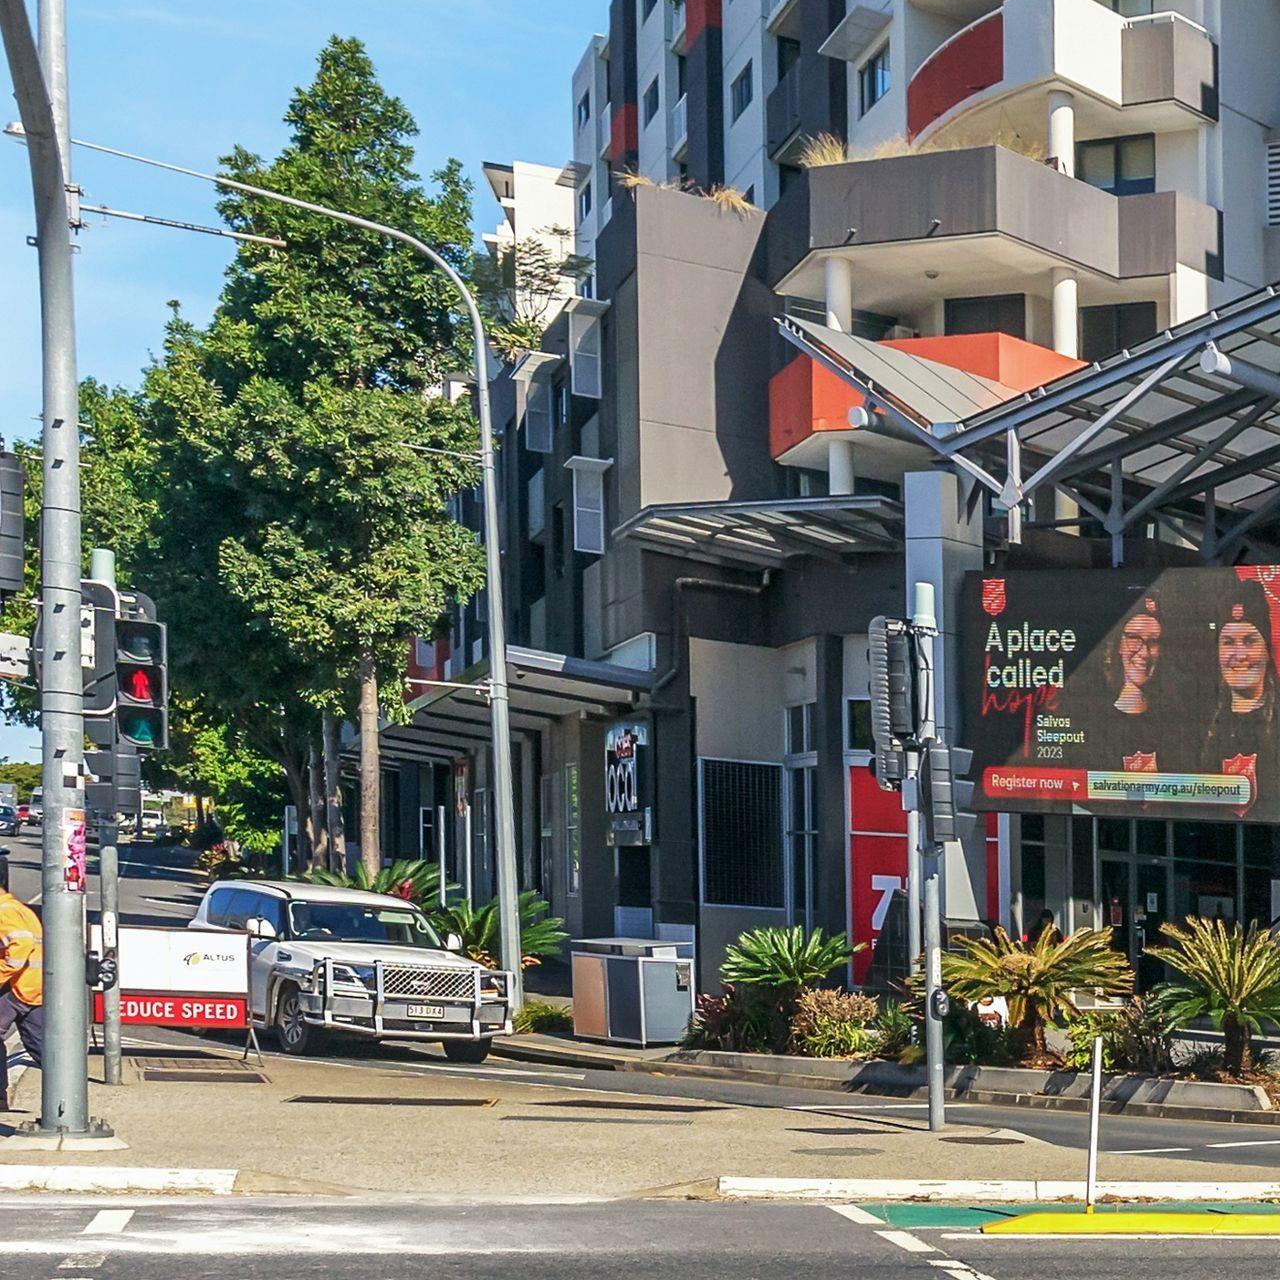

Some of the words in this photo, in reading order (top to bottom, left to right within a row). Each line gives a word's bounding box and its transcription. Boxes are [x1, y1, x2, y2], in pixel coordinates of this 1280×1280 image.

[984, 621, 1005, 652] A
[1006, 622, 1077, 660] place
[986, 658, 1064, 688] called
[1036, 714, 1070, 728] Salvos
[1036, 729, 1085, 745] Sleepout
[1036, 746, 1063, 759] 2023
[991, 775, 1037, 791] Register
[1040, 778, 1064, 789] now
[202, 953, 236, 962] ALTUS
[118, 1000, 175, 1019] EDUCE
[181, 1003, 239, 1021] SPEED
